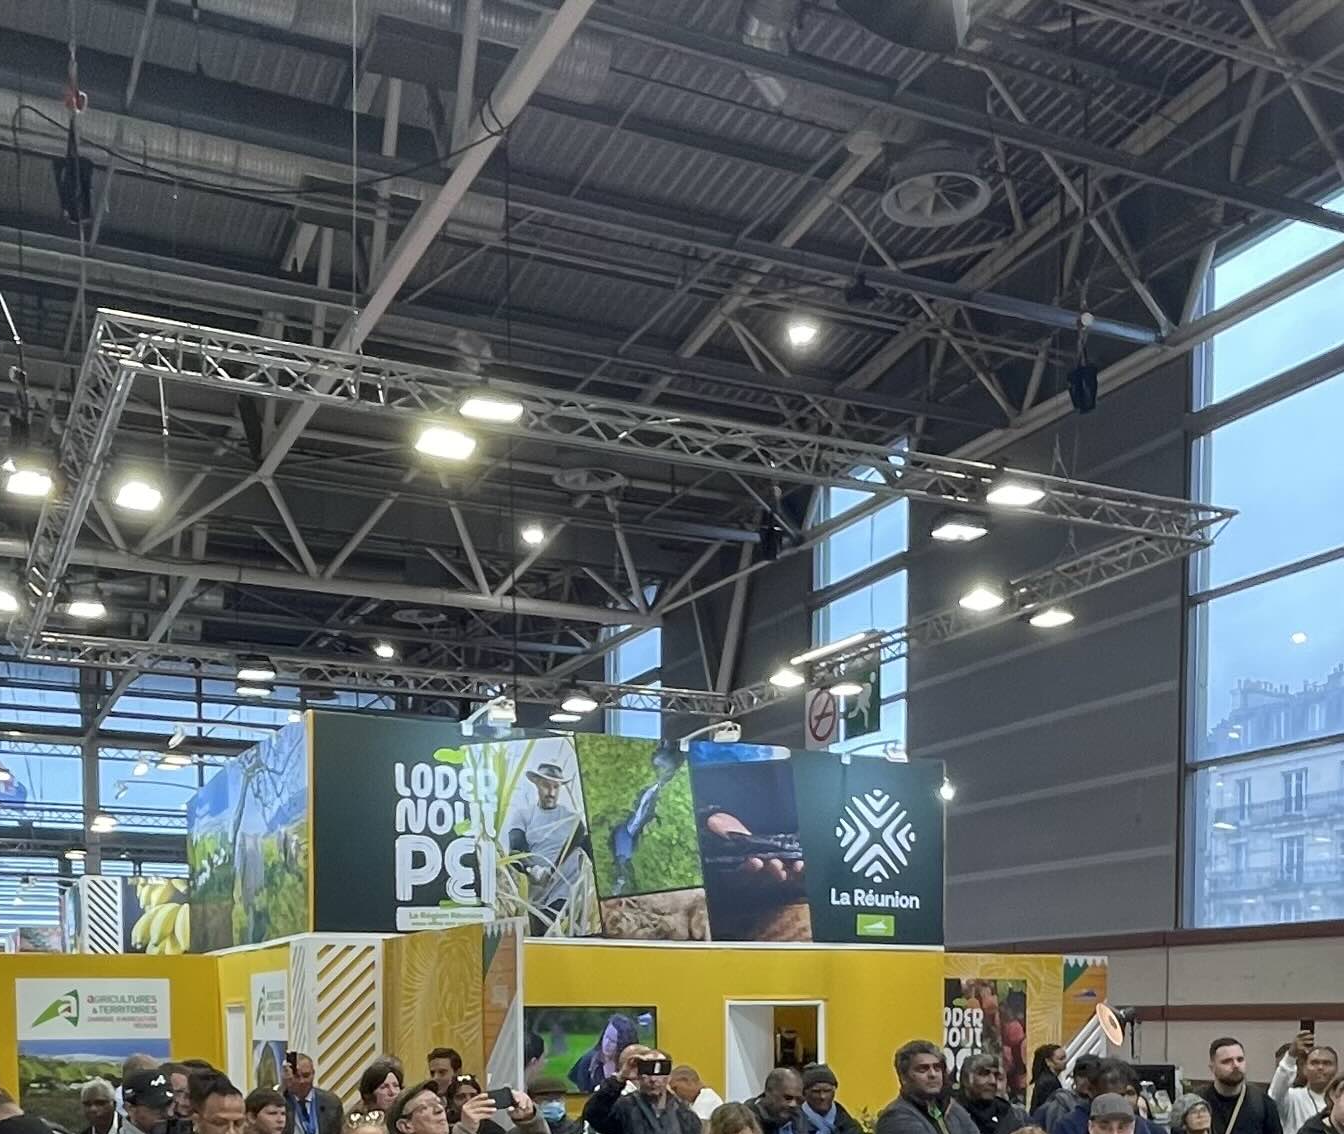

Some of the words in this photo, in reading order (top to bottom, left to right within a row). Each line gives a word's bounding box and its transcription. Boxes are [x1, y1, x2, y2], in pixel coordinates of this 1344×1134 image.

[395, 763, 497, 801] LODER
[830, 888, 851, 905] La
[854, 889, 920, 909] Réunion
